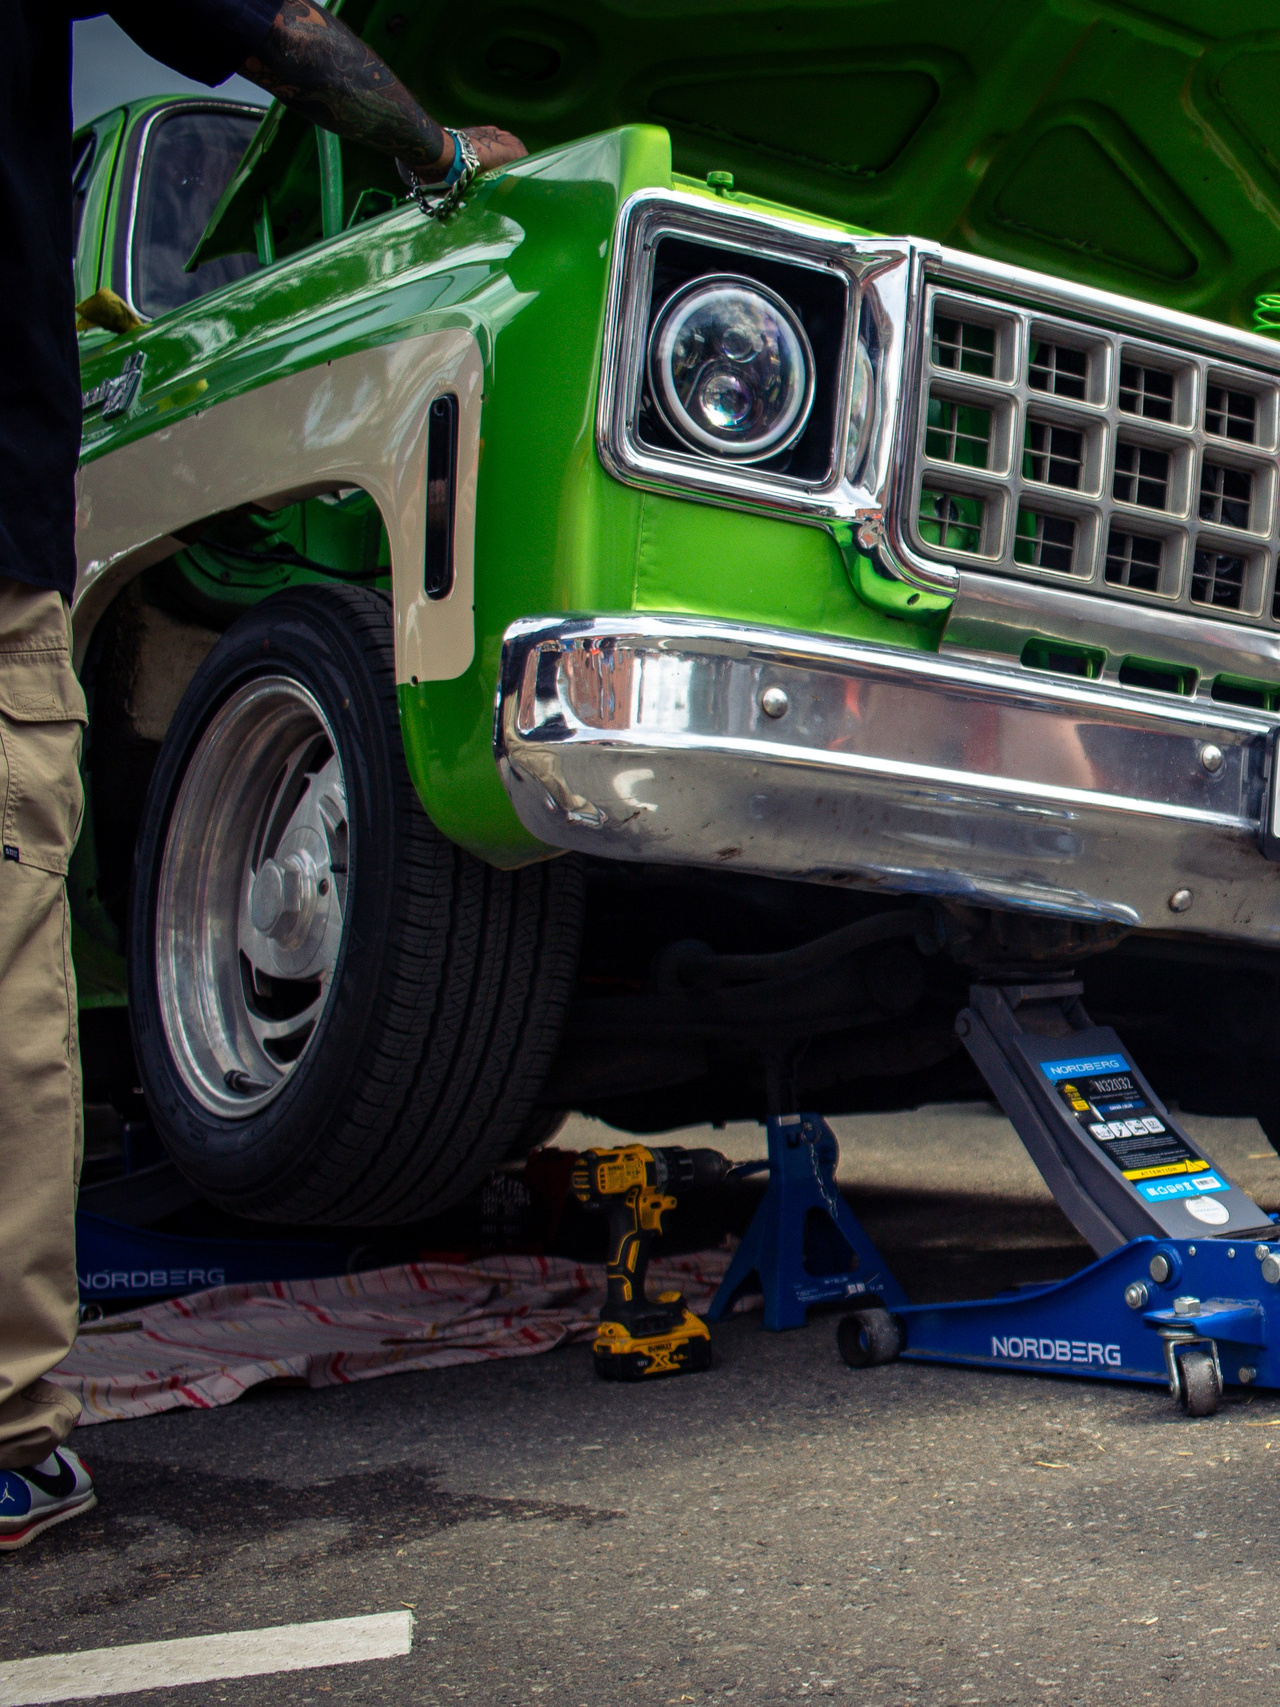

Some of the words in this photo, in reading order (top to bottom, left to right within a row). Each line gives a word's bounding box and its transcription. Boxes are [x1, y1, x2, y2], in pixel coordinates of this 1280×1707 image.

[1050, 1060, 1120, 1075] NORDBERG
[1095, 1077, 1134, 1093] N32032
[1140, 1166, 1178, 1177] ATTENTION
[78, 1268, 225, 1290] NORDBERG
[991, 1336, 1122, 1366] NORDBERG
